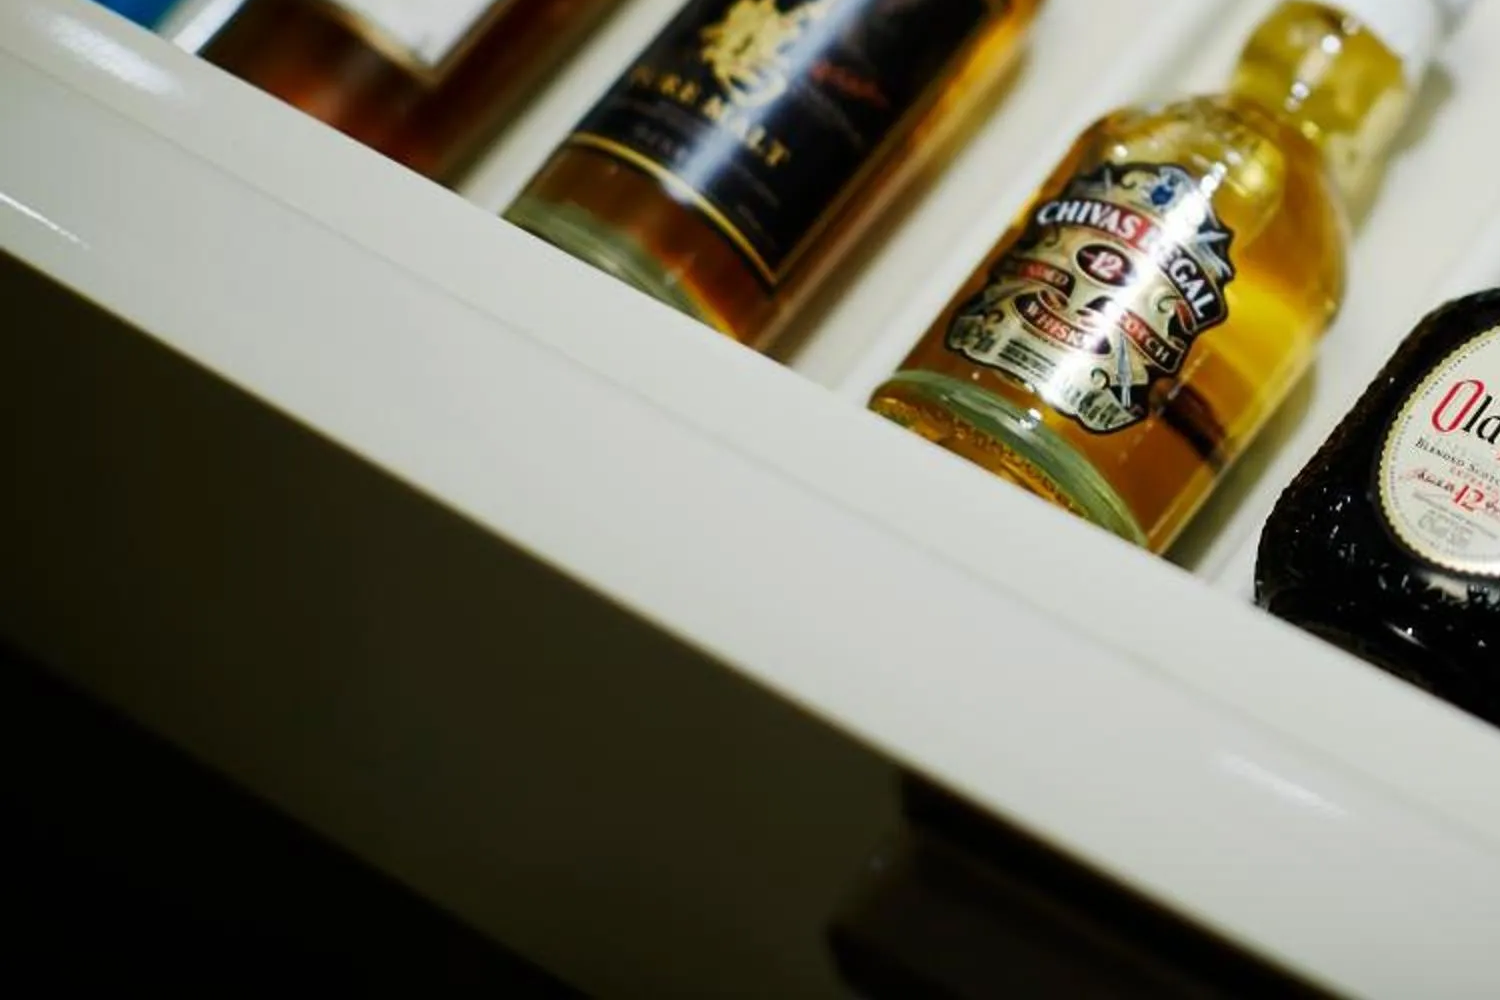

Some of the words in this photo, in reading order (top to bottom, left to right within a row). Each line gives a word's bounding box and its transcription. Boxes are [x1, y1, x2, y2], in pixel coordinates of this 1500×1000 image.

[1037, 199, 1139, 238] CHIVAS
[1088, 252, 1120, 280] 12
[1453, 483, 1486, 513] 12
